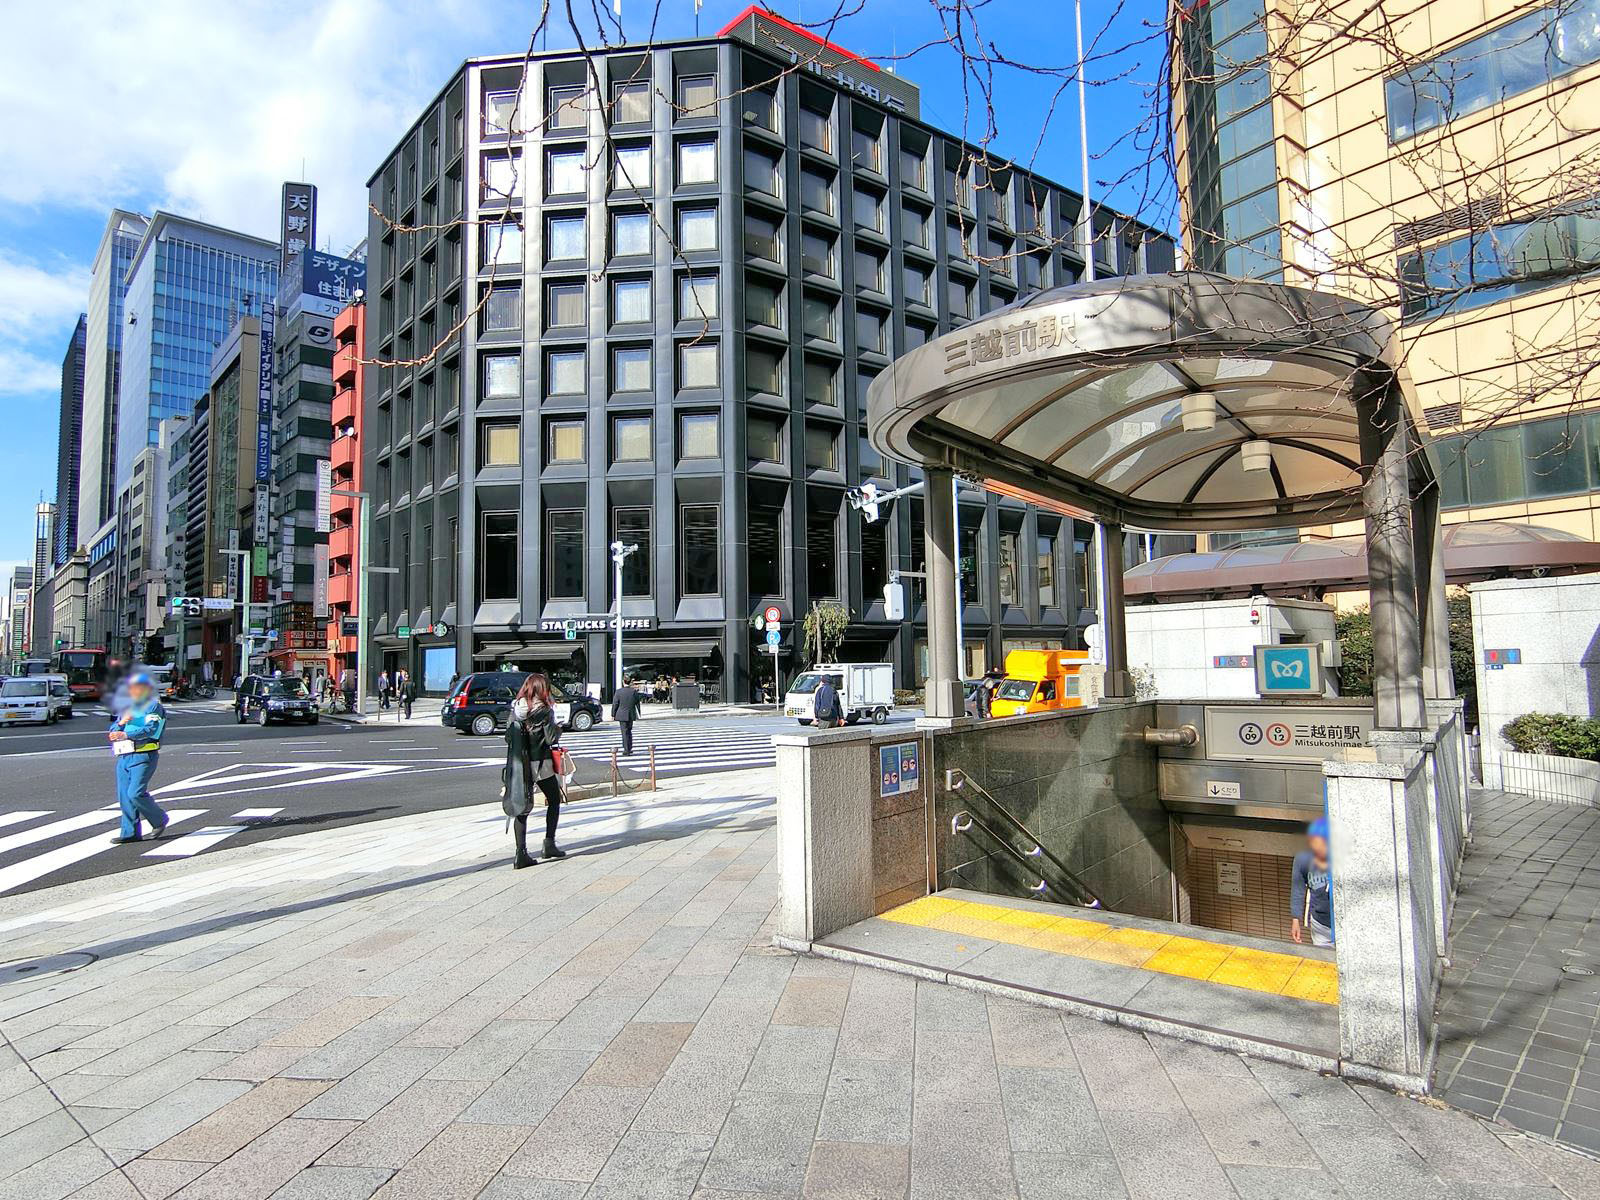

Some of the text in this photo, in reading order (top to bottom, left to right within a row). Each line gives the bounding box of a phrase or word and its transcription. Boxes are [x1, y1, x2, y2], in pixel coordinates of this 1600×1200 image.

[312, 255, 366, 278] デザイン
[943, 312, 1078, 375] 三越前駅
[541, 619, 650, 630] STAUCKS CFFEE
[1245, 733, 1257, 741] 09
[1295, 724, 1361, 740] 三越前駅
[1273, 734, 1285, 742] 12
[1295, 739, 1363, 748] Mitsukoshimae
